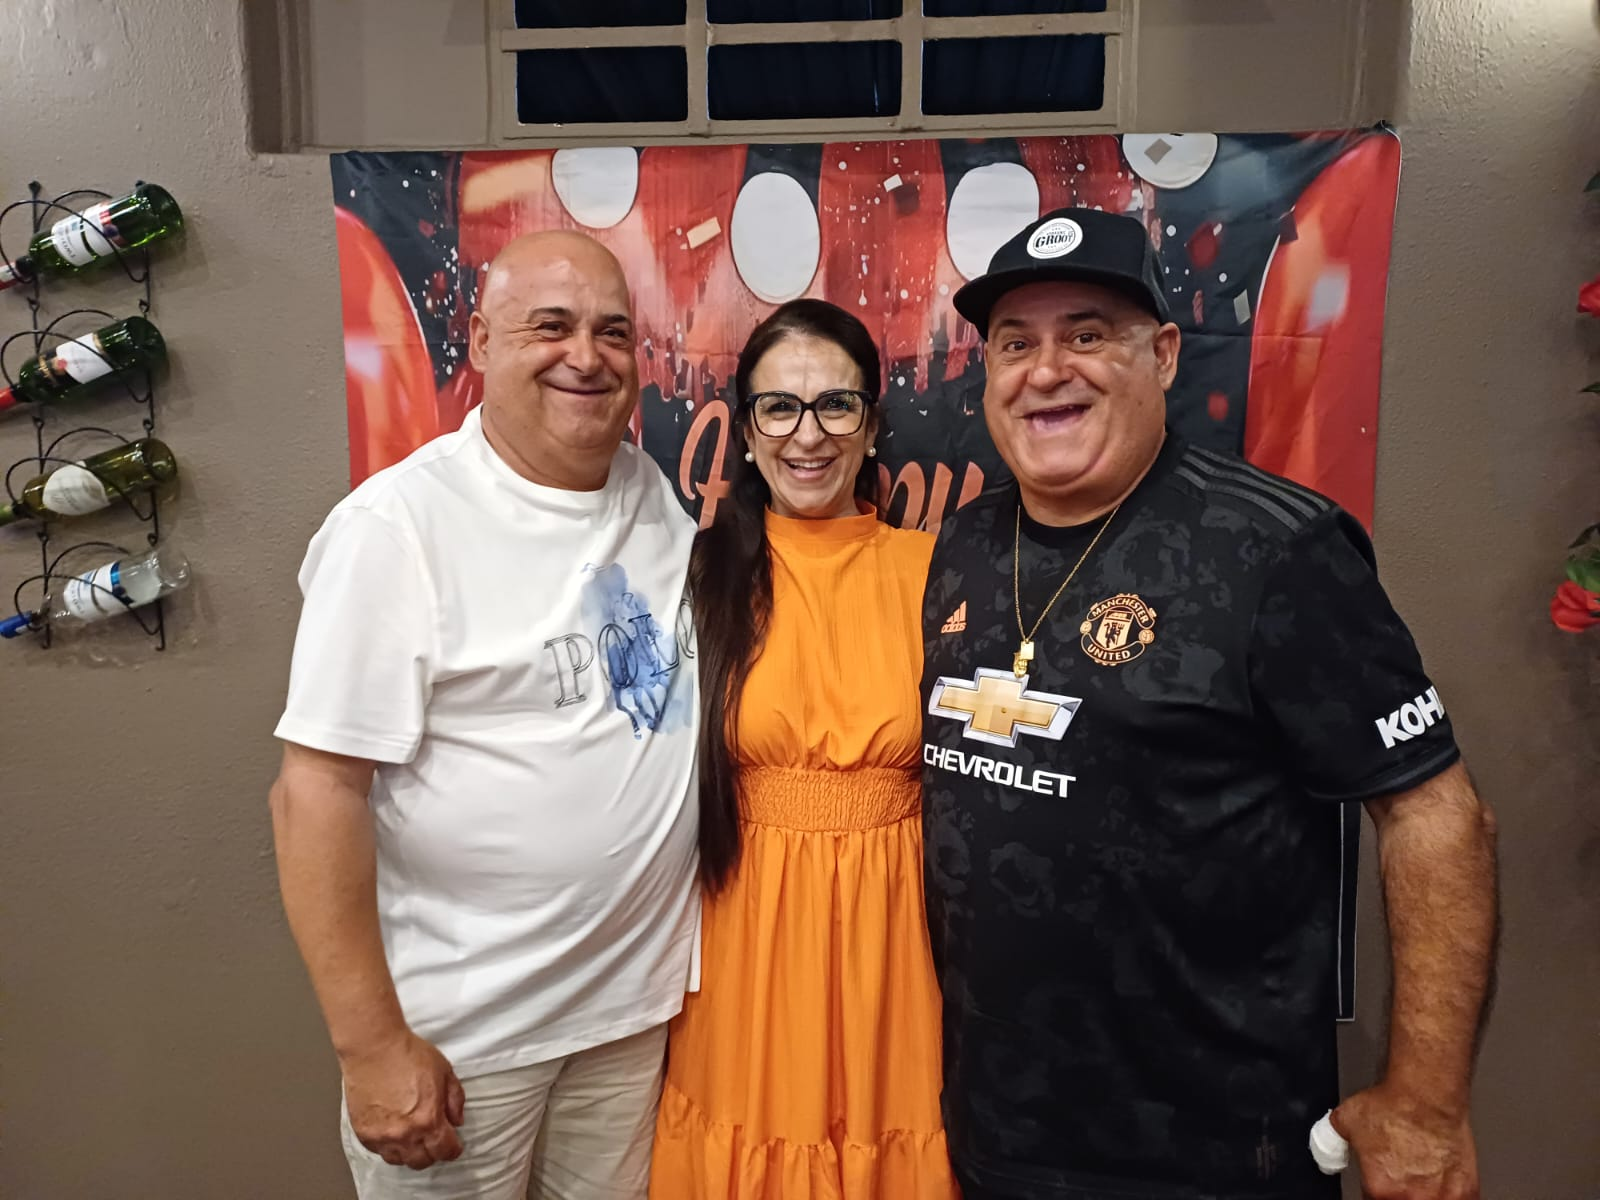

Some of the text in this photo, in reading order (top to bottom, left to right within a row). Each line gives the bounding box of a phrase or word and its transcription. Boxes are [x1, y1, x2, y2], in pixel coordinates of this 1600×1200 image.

[1092, 597, 1149, 623] MANCHESTER
[1087, 643, 1131, 661] UNITED
[924, 744, 1076, 797] CHEVROLET
